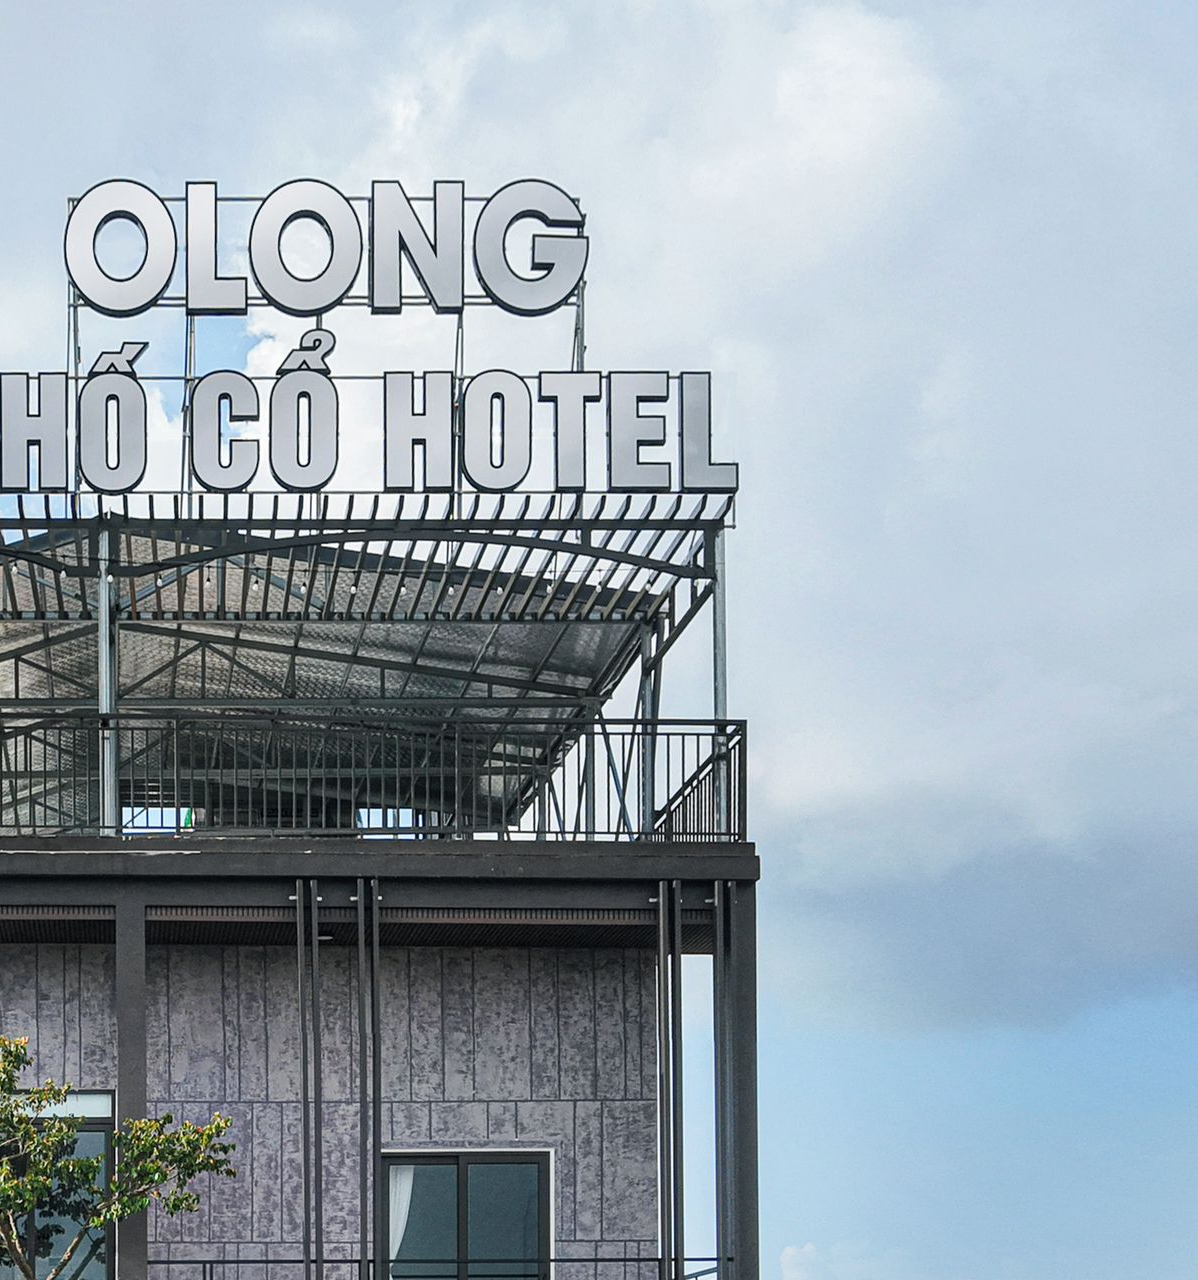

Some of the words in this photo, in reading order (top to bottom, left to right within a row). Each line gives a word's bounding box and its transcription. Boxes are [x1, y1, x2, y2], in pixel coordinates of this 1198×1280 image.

[64, 178, 589, 317] OLONG
[189, 328, 339, 493] CỔ
[383, 369, 739, 493] HOTEL
